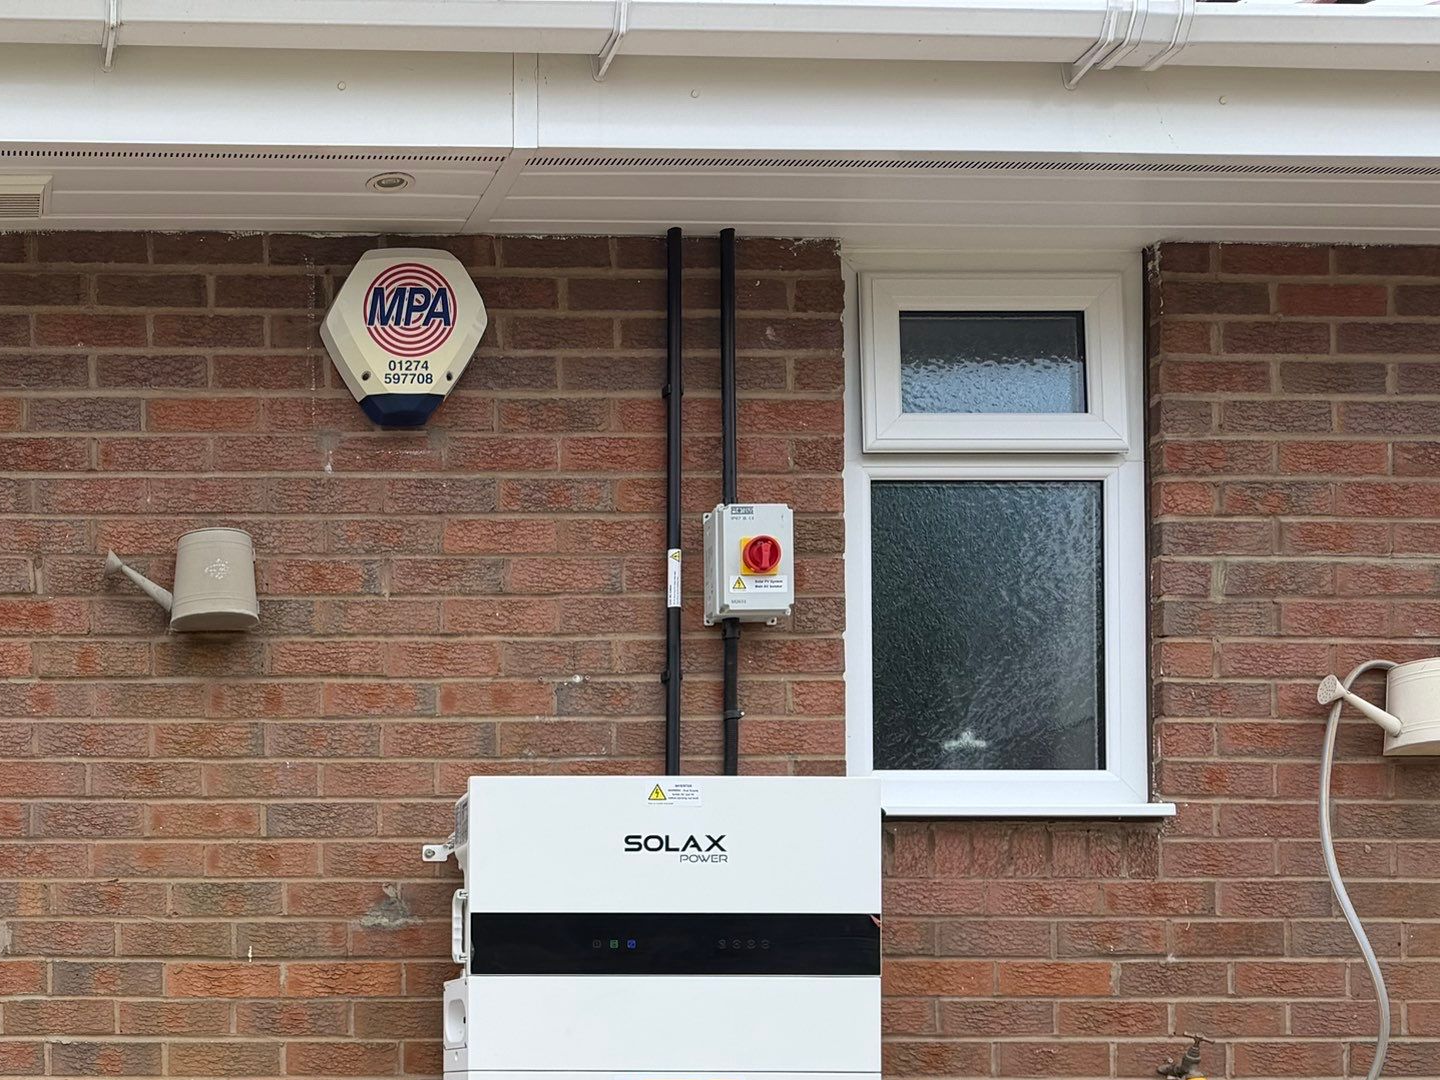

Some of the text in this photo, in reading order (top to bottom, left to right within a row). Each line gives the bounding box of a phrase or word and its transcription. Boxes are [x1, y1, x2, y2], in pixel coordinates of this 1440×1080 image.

[367, 287, 451, 326] MPA
[388, 360, 429, 371] 01274
[384, 373, 433, 384] 597708
[624, 835, 727, 852] SOLAX
[679, 854, 728, 863] POWER
